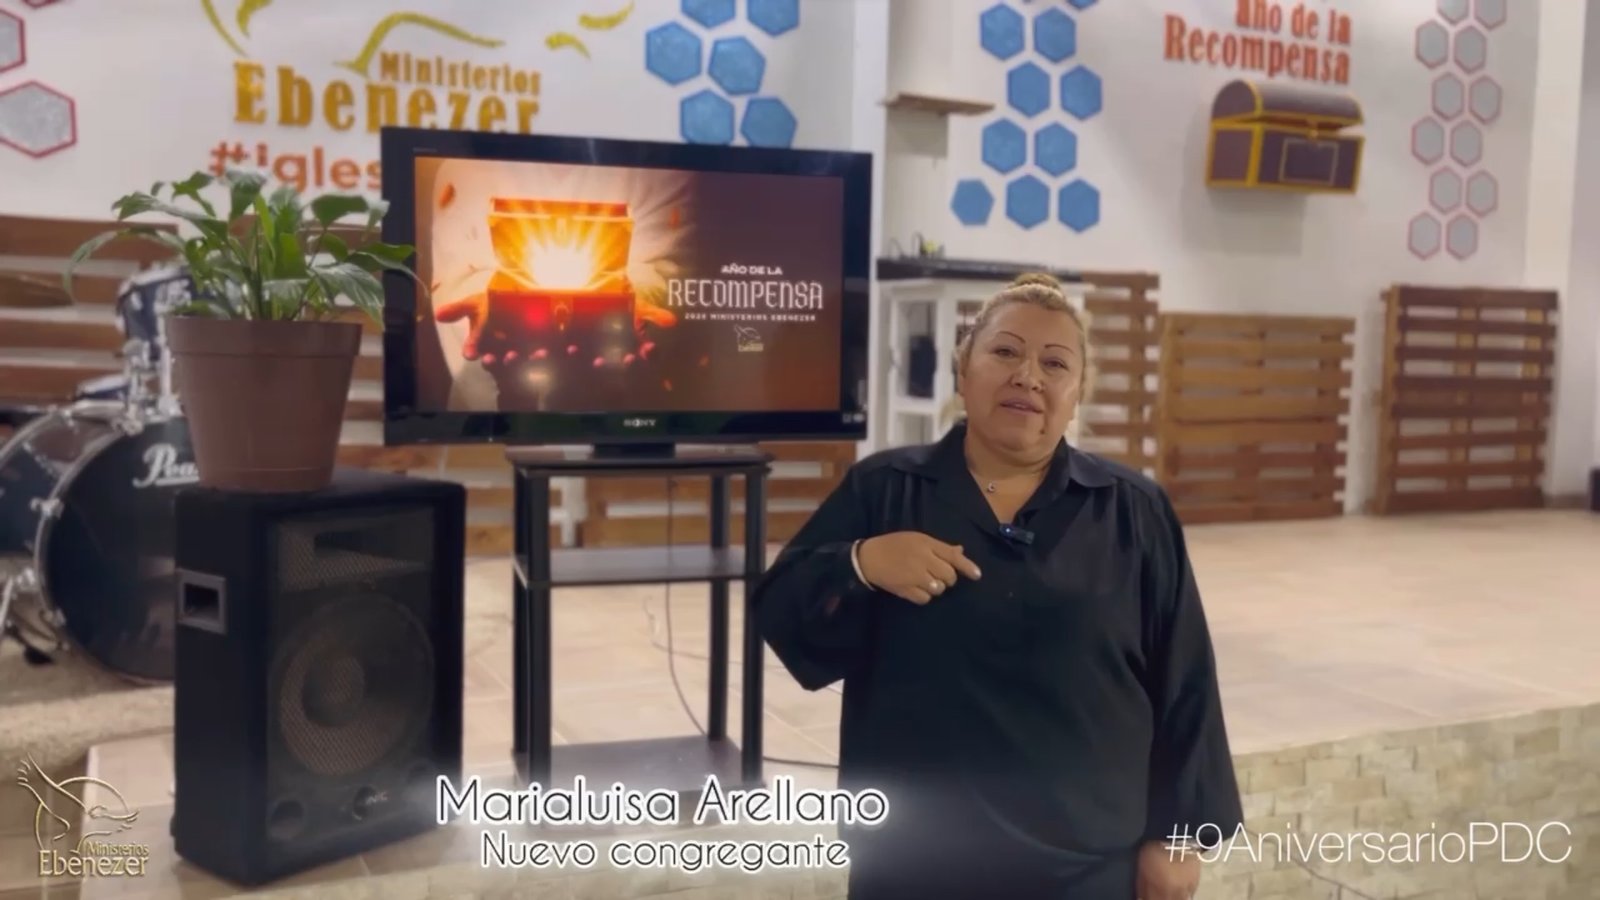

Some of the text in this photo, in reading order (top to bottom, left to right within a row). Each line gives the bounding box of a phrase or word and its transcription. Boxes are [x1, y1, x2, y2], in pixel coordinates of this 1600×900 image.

[1291, 5, 1319, 39] de
[1328, 9, 1351, 44] la
[1164, 14, 1350, 84] Recompensa
[380, 51, 541, 95] Ministerios
[233, 60, 540, 135] Ebenezer
[721, 263, 783, 275] AÑO DE LA
[668, 279, 824, 310] RECOMPENSA
[623, 418, 656, 427] SONY
